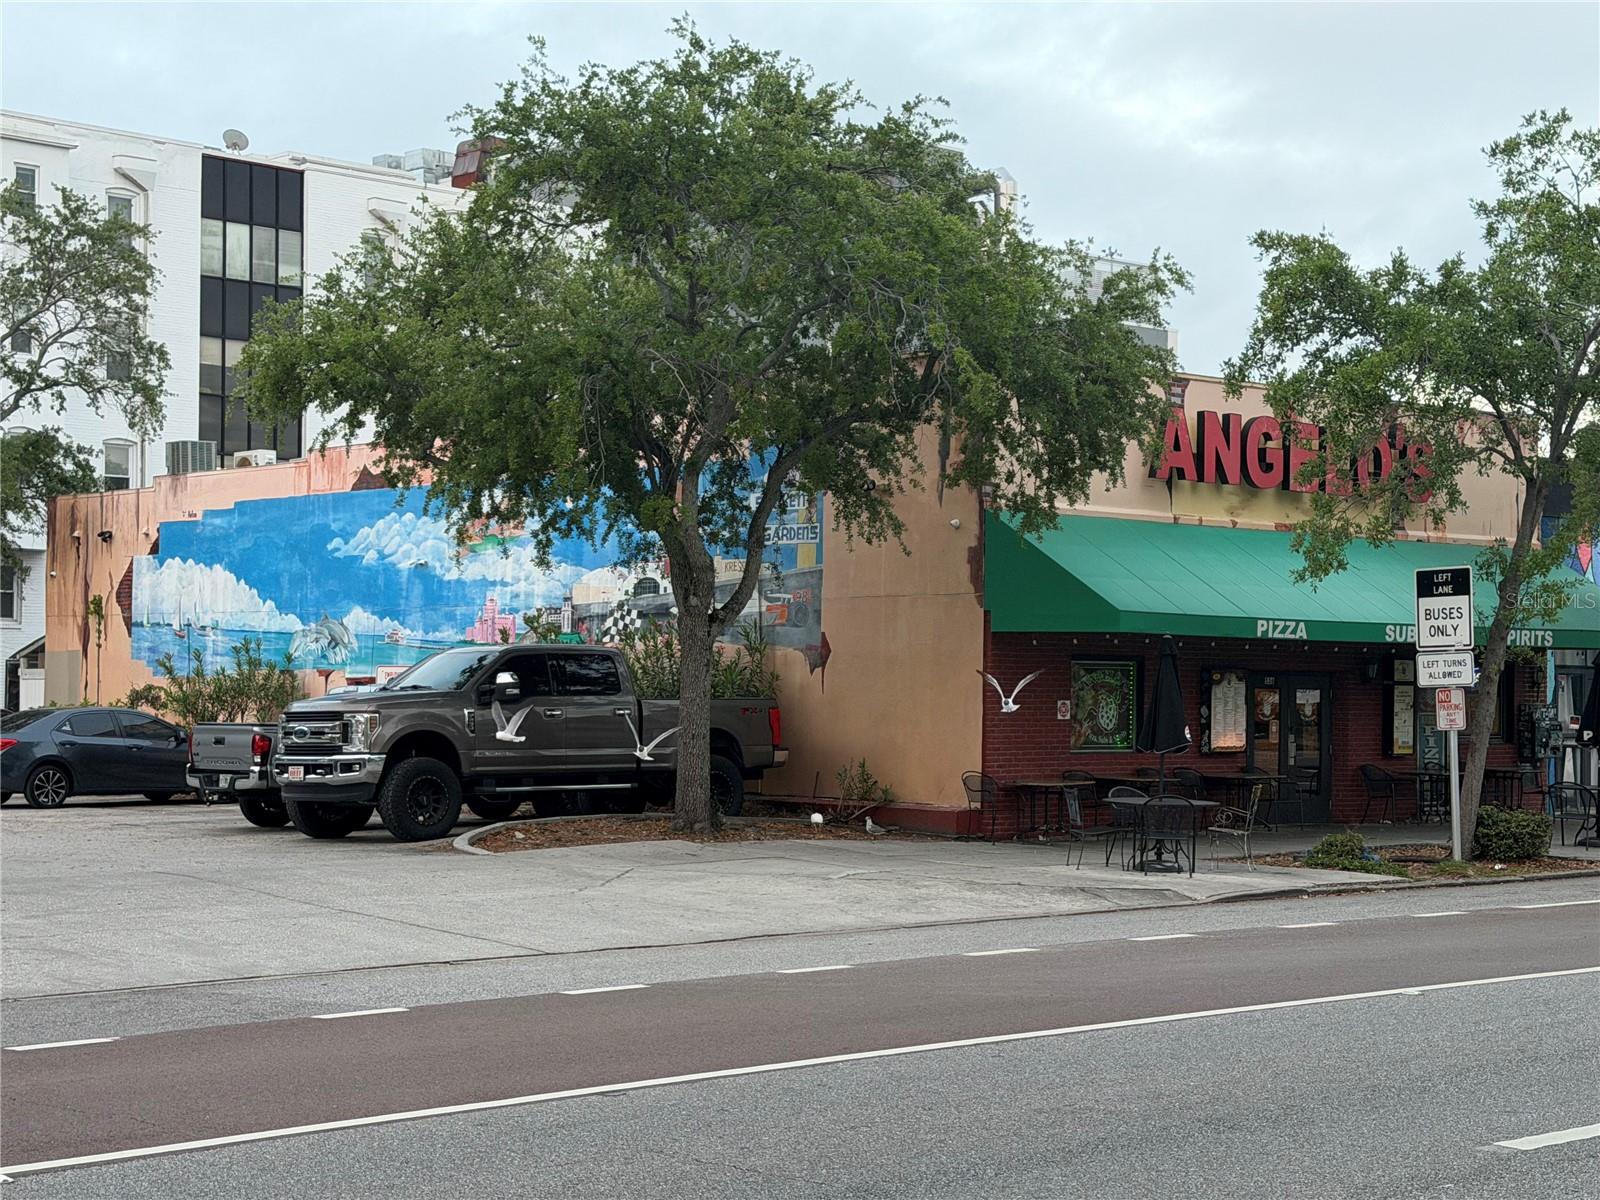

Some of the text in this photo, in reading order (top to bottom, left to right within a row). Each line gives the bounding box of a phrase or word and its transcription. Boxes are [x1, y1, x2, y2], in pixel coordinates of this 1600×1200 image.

[1434, 573, 1451, 583] LEFT
[1433, 585, 1454, 594] LANE
[1424, 606, 1464, 621] BUSES
[1257, 619, 1308, 640] PIZZA
[1428, 624, 1460, 638] ONLY
[1506, 629, 1553, 647] PIRITS
[1422, 658, 1468, 669] LEFT TURNS
[1428, 670, 1462, 680] ALLOWED
[1438, 691, 1451, 702] NO
[1439, 703, 1463, 712] PARKING
